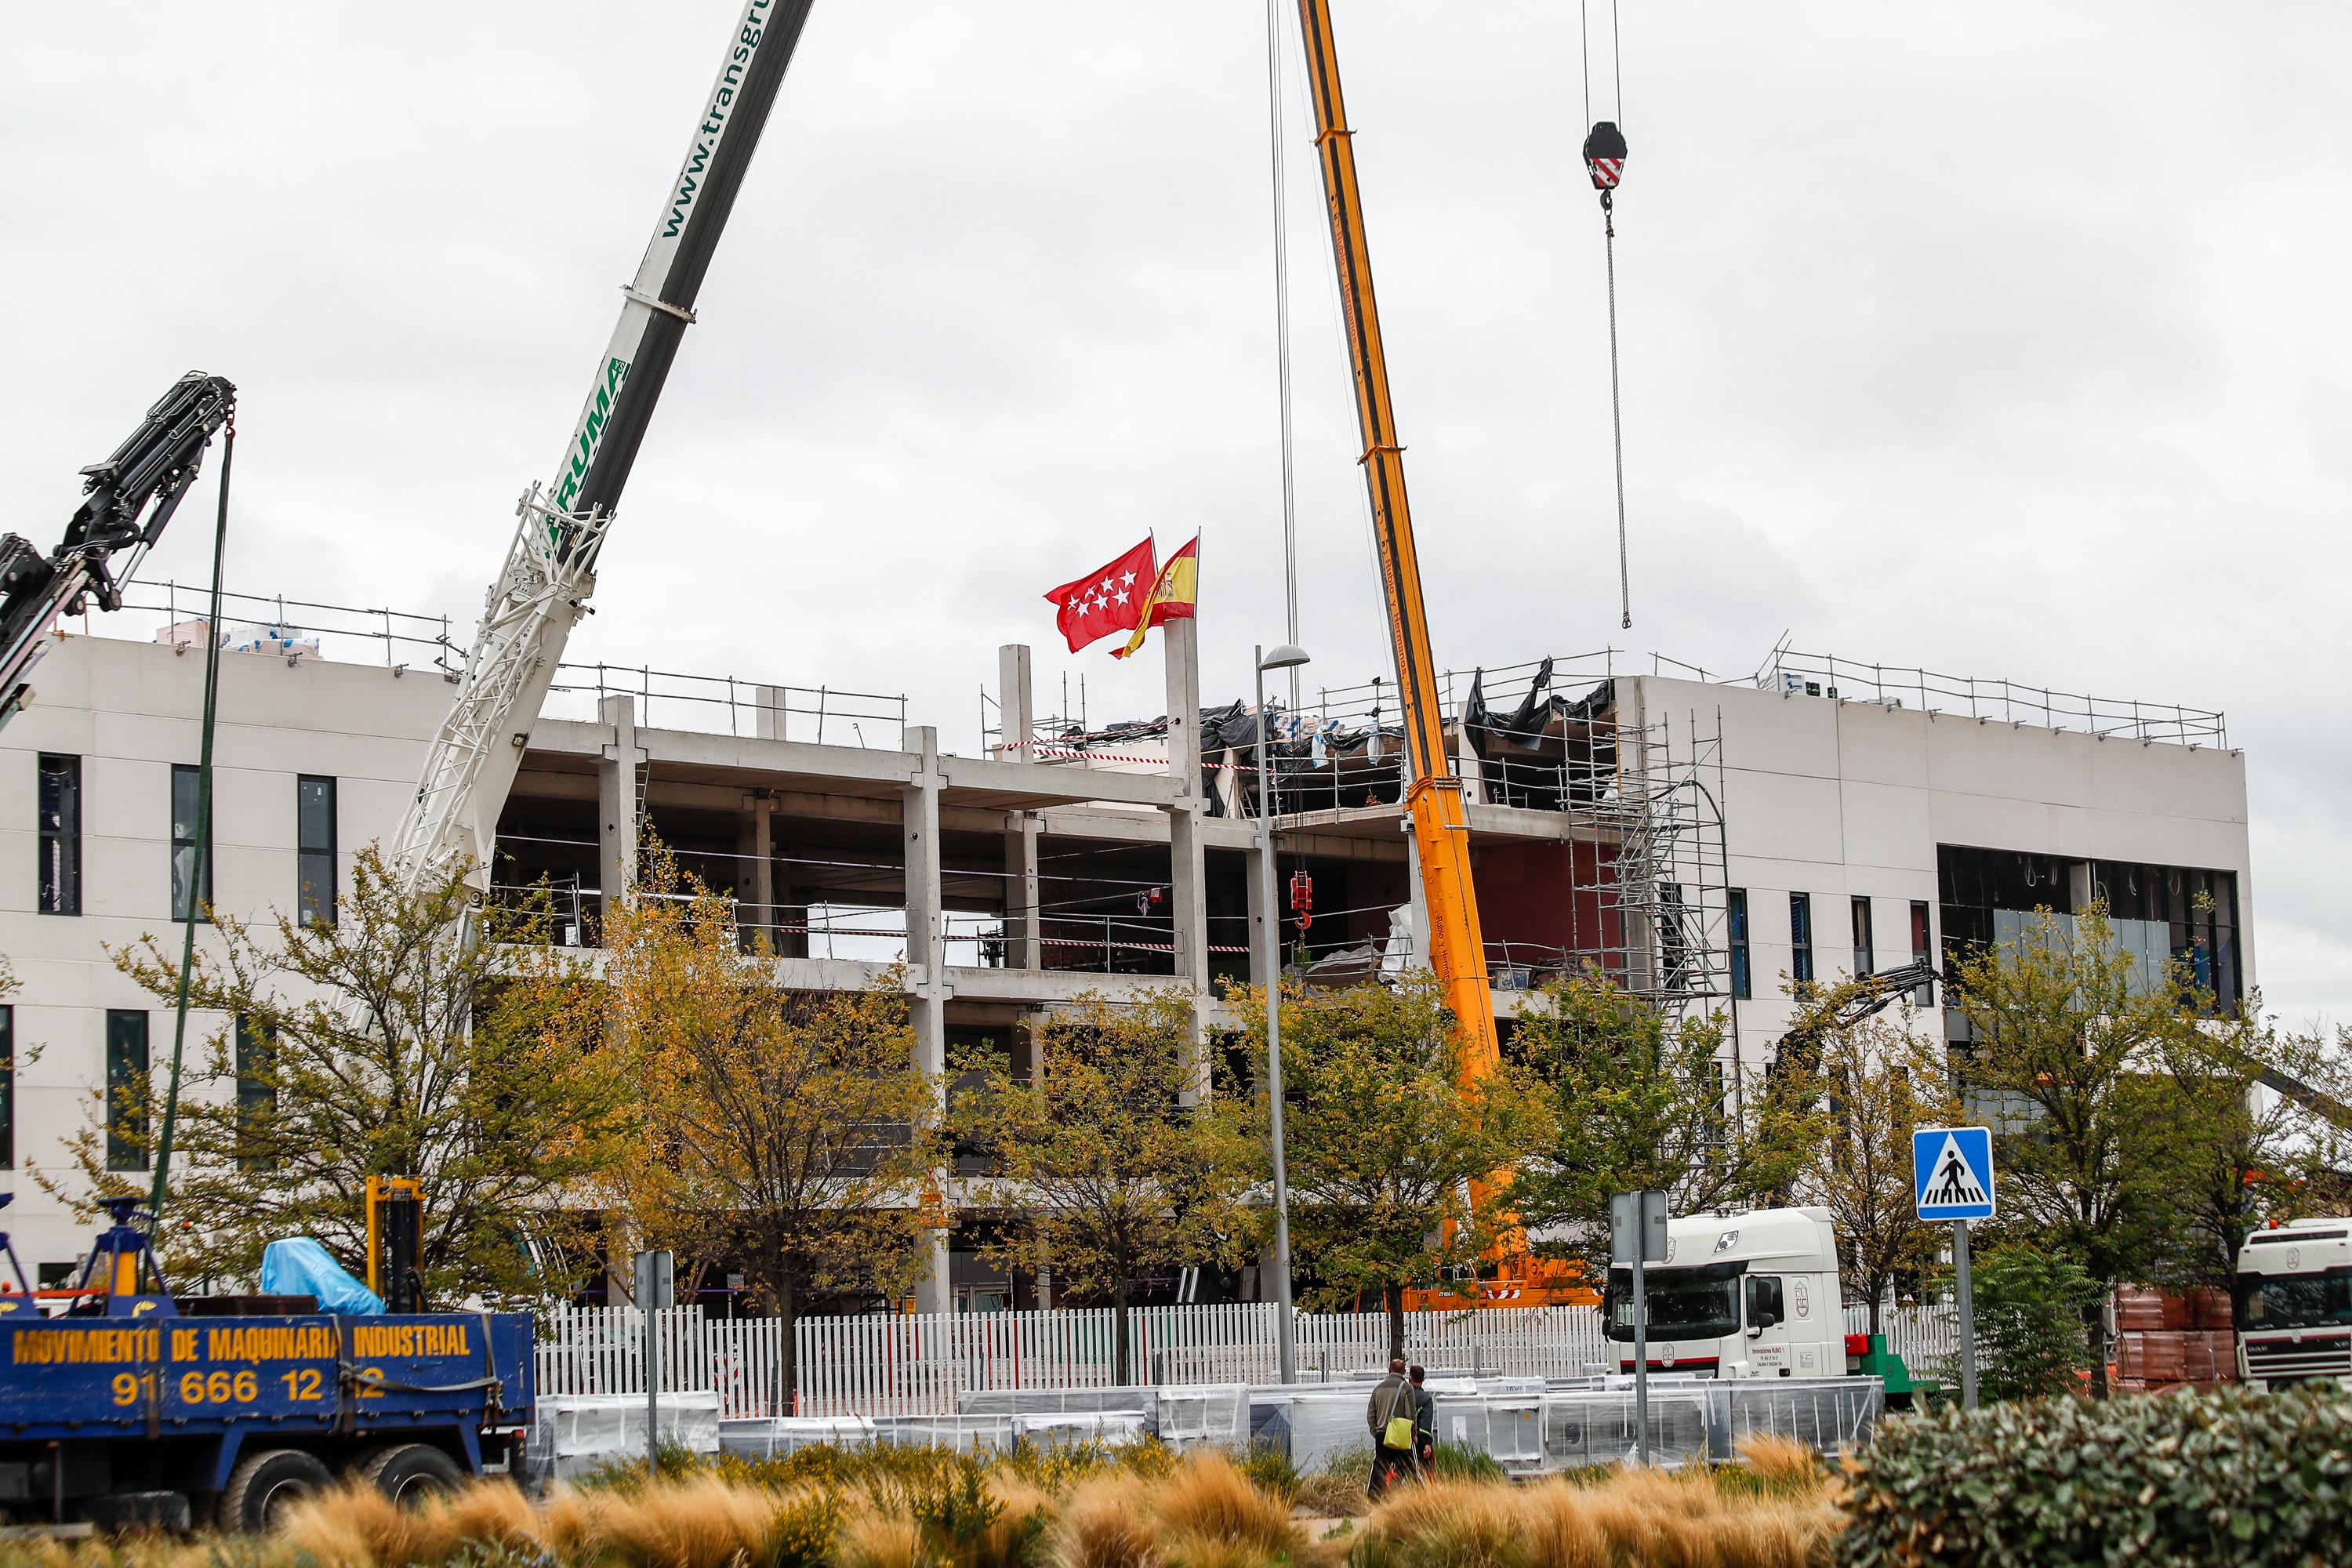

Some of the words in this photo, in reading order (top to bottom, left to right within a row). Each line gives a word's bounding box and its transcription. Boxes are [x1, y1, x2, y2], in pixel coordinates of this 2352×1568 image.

[1336, 233, 1346, 264] Rubio
[1384, 559, 1395, 594] Rubio
[1393, 612, 1407, 680] Hermanos,
[1436, 915, 1444, 940] Rubio
[13, 1329, 160, 1365] MOVIMIENTO
[171, 1328, 199, 1363] DE
[208, 1326, 342, 1366] MAQUINARIA
[354, 1324, 470, 1358] INDUSTRIAL
[111, 1372, 157, 1407] 91
[179, 1370, 259, 1405] 666
[281, 1367, 323, 1402] 12
